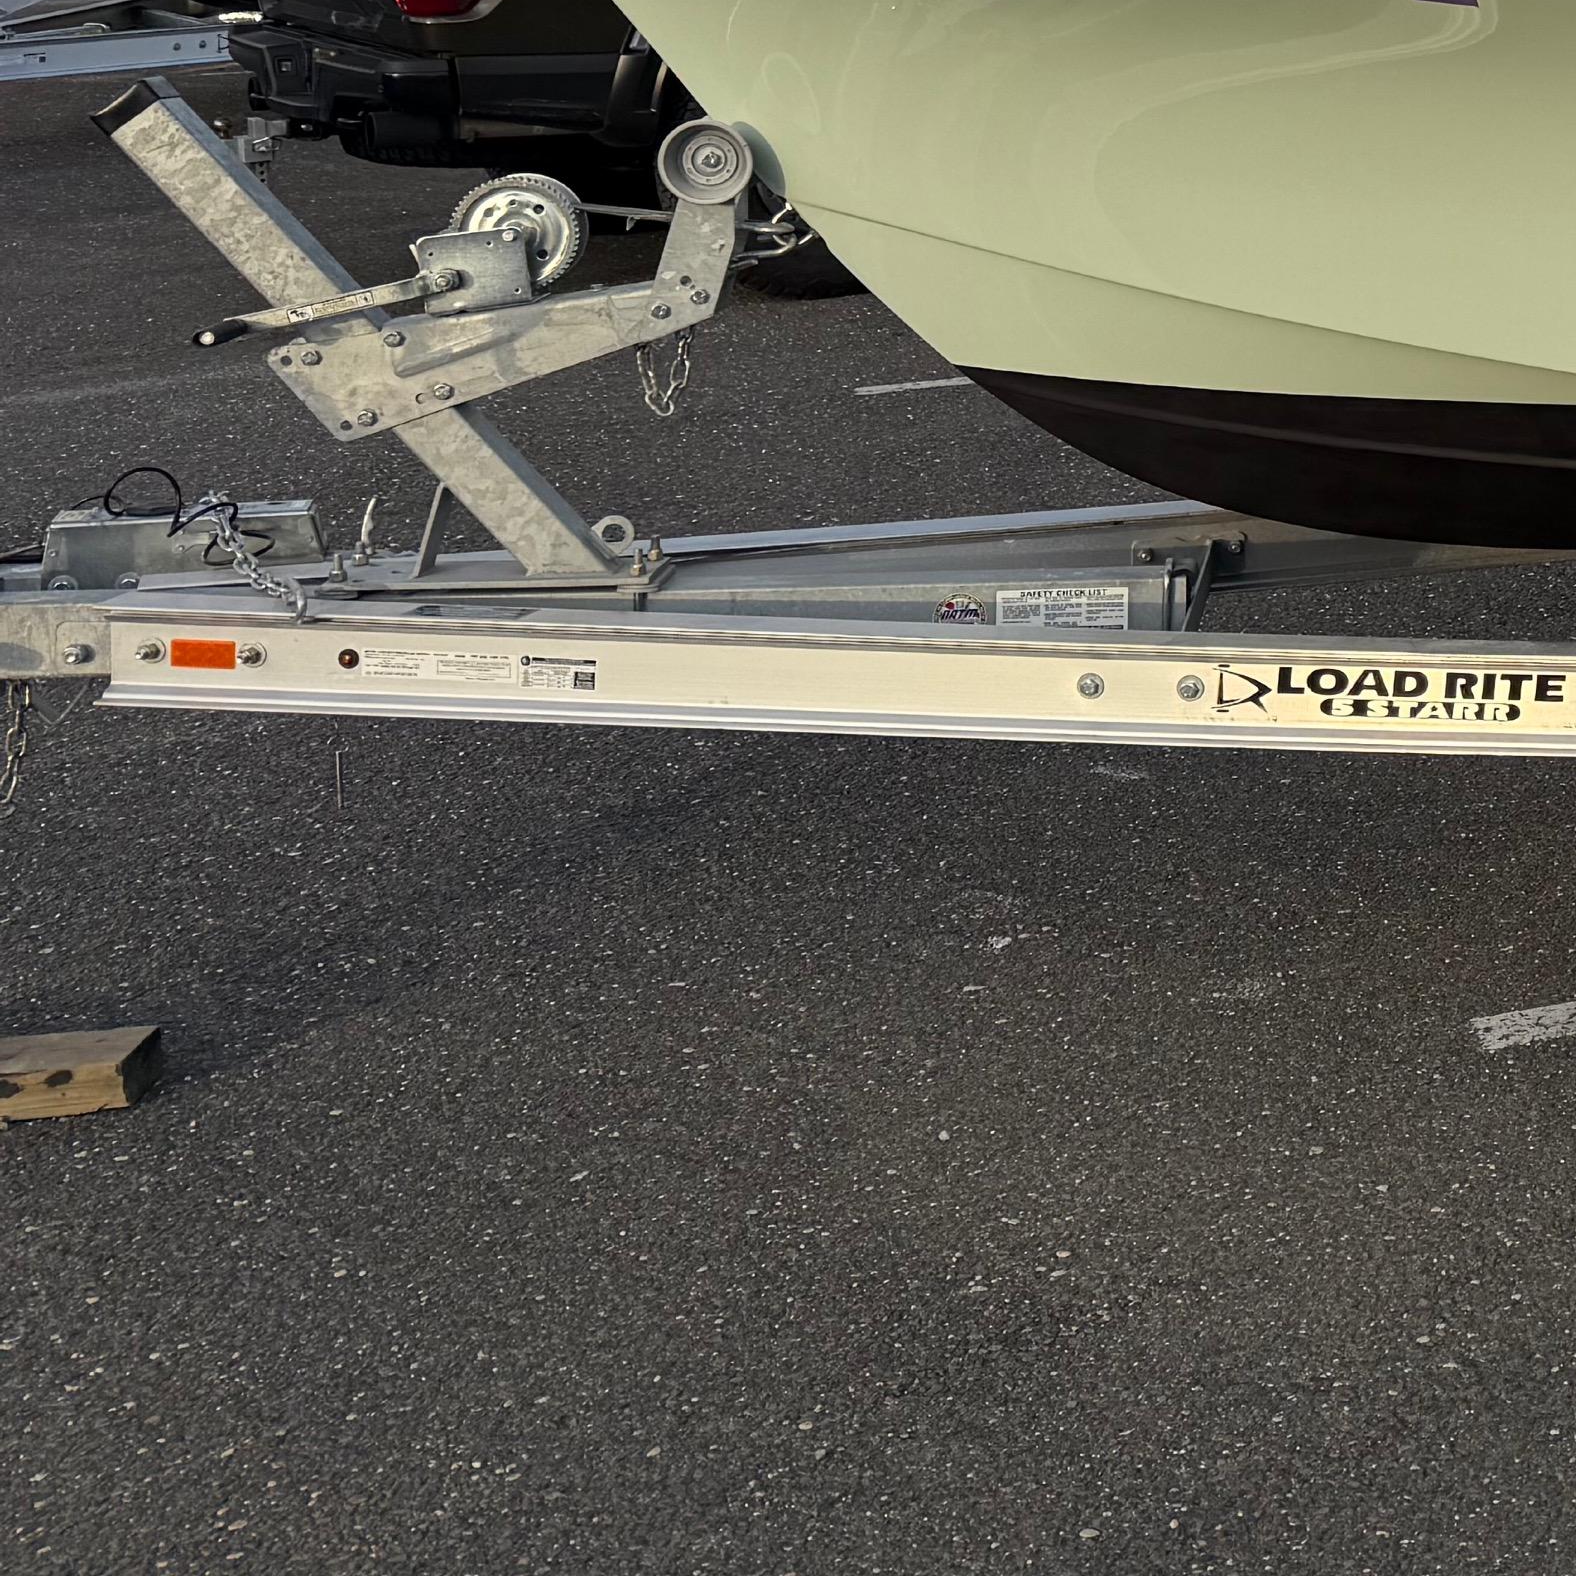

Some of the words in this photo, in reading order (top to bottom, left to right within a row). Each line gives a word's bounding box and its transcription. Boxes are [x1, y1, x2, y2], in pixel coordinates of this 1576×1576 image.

[1277, 666, 1429, 698] LOAD
[1444, 671, 1567, 703] RITE
[1331, 698, 1355, 717] 5
[1366, 699, 1511, 722] STARR
